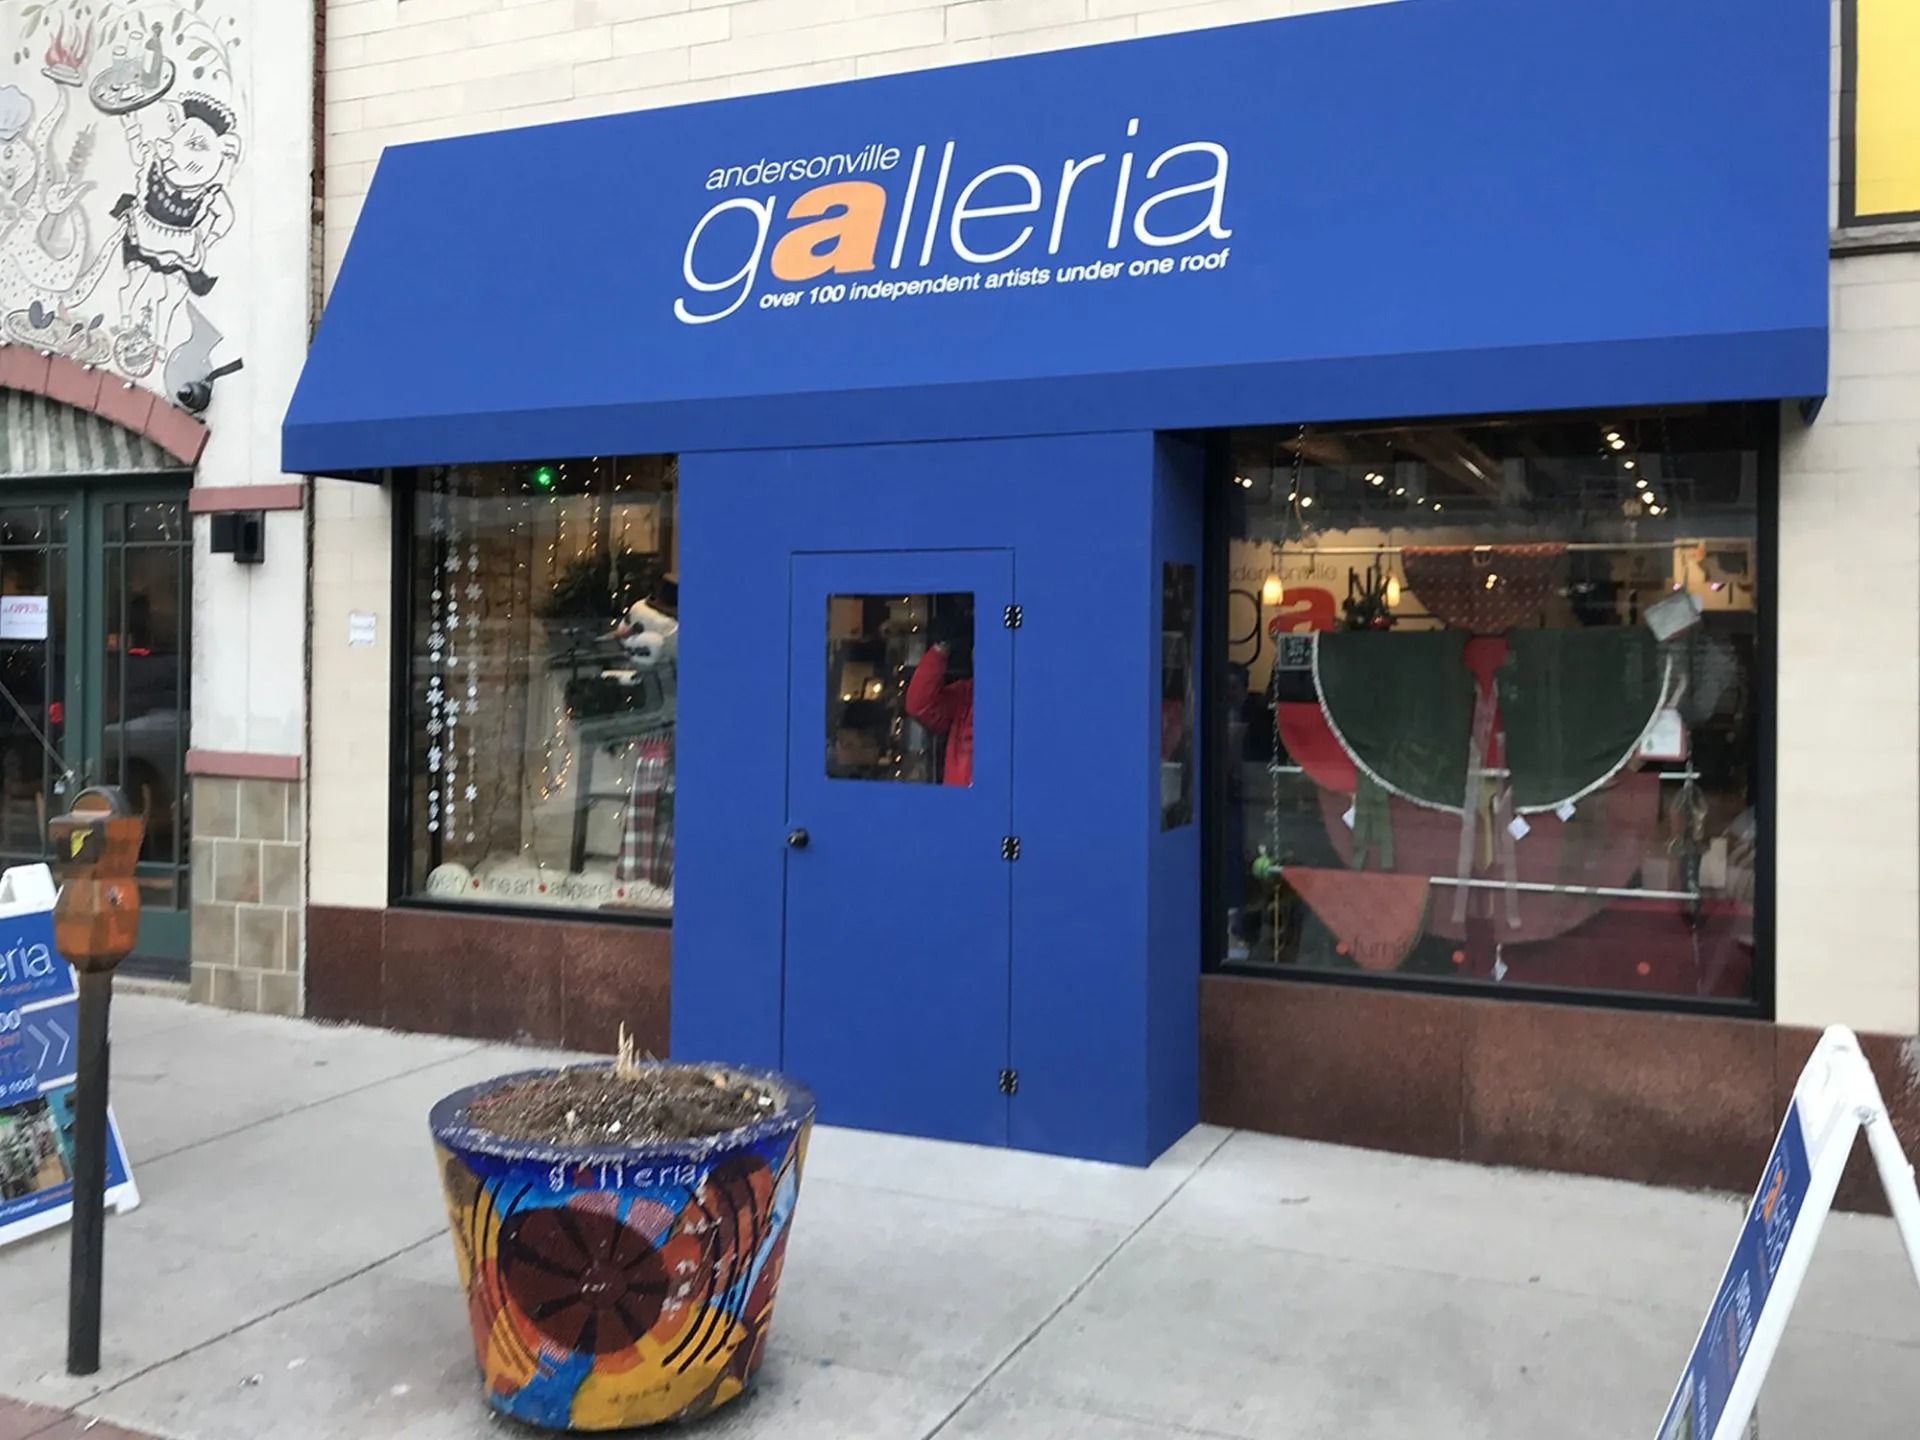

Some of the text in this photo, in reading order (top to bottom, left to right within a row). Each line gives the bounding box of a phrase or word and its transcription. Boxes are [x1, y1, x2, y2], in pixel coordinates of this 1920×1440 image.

[705, 143, 901, 190] andersonville
[673, 117, 1233, 325] galleria
[759, 247, 1231, 310] over 100 independent artists under one roof
